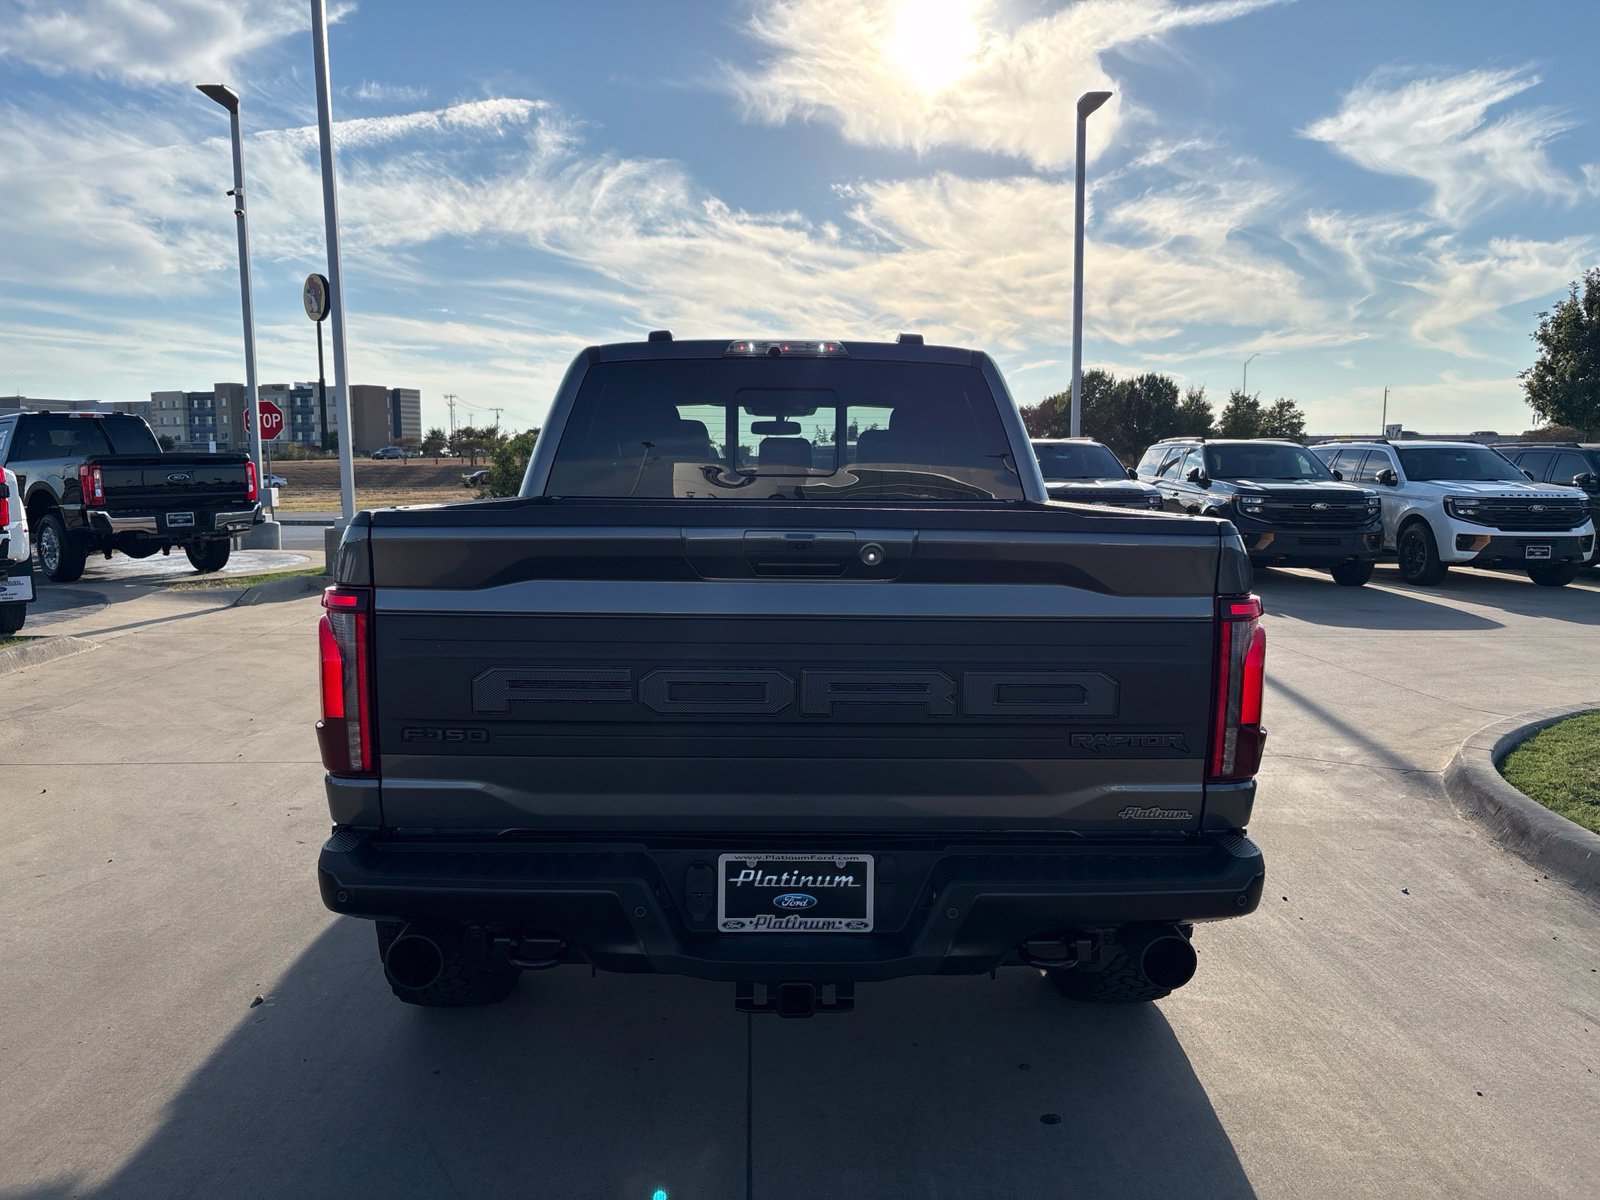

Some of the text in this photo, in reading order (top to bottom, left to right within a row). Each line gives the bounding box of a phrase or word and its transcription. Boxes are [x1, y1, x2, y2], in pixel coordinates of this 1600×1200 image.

[472, 665, 1120, 718] FORD
[401, 726, 490, 743] F-150
[1069, 732, 1190, 754] RAPTOR
[1119, 805, 1193, 820] Platinum
[734, 854, 860, 862] www.PlatinumFord.com
[728, 869, 861, 887] Platinum
[781, 895, 808, 907] Ford
[753, 915, 841, 930] Platinum
